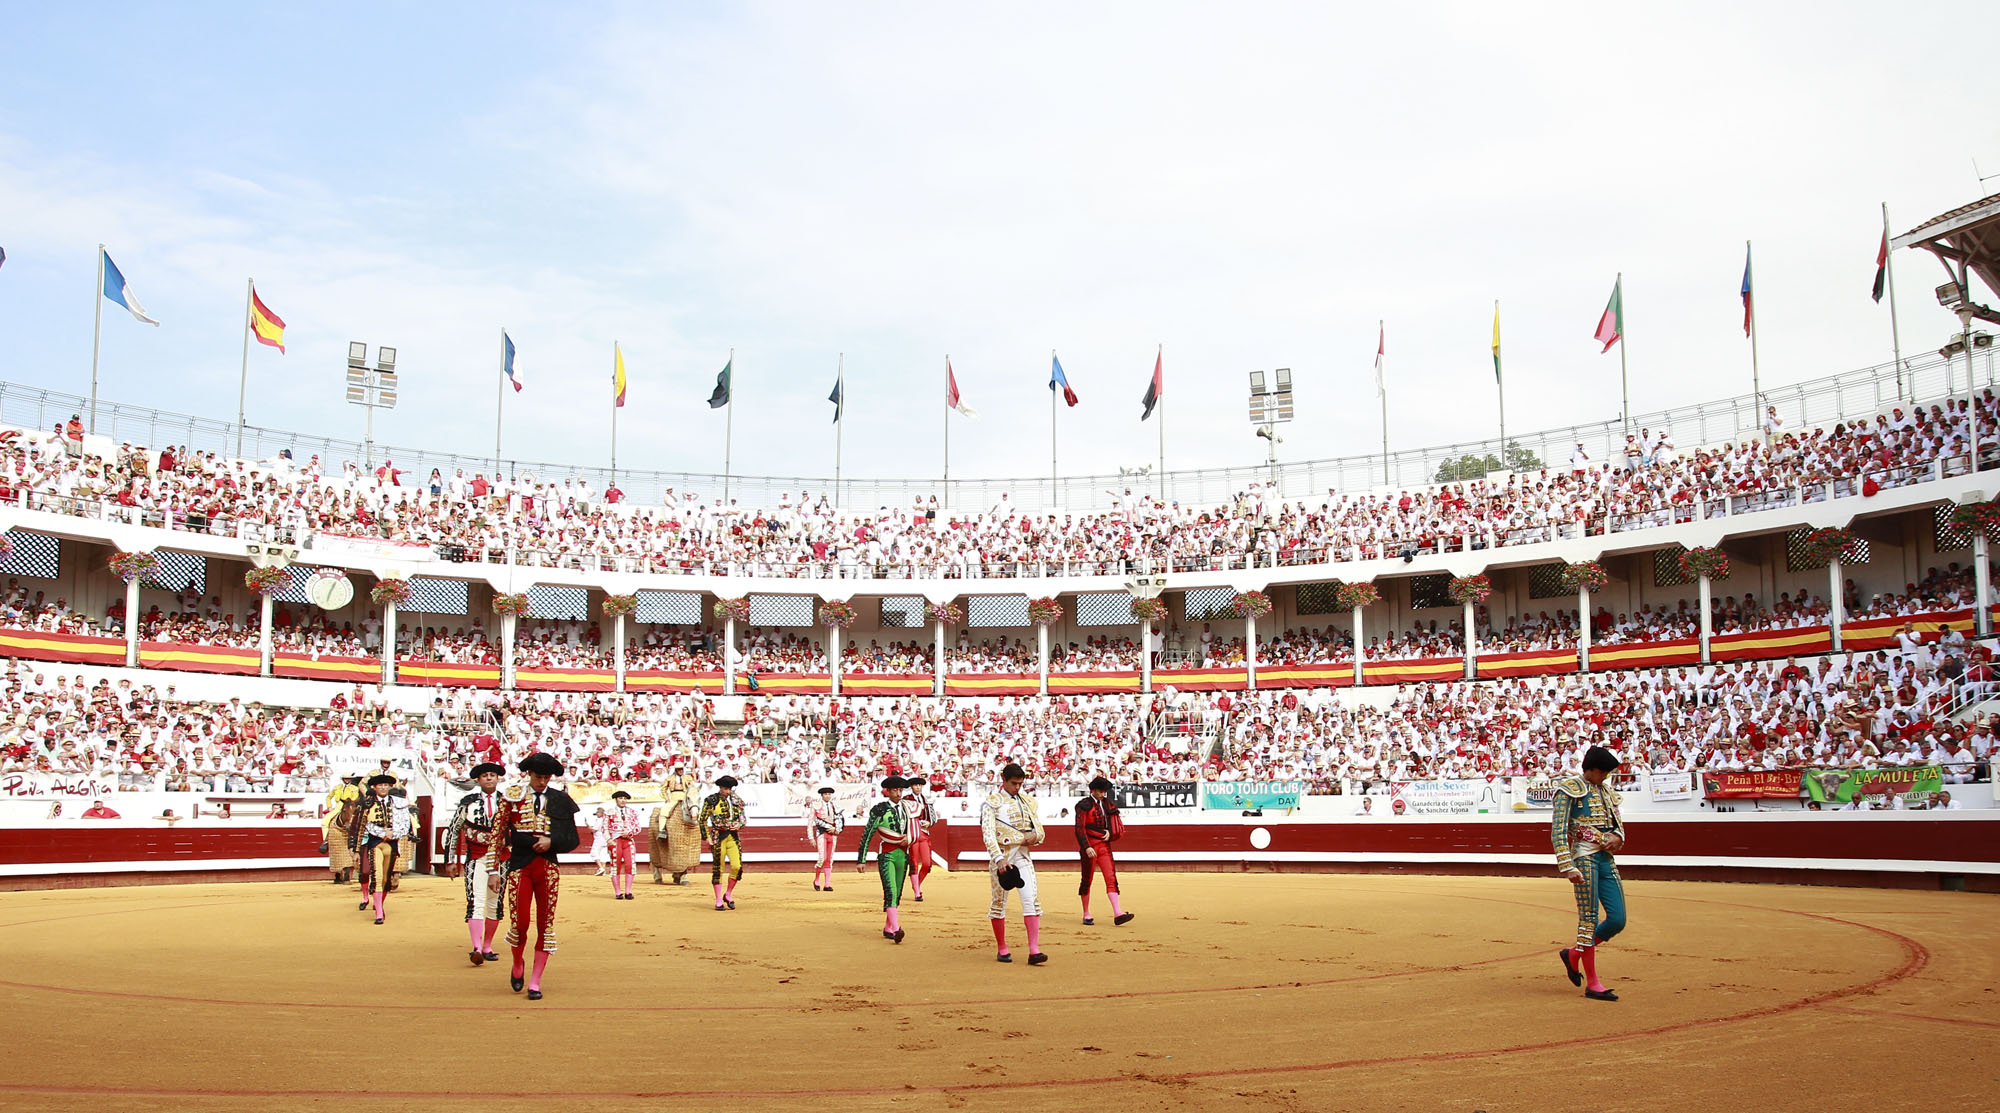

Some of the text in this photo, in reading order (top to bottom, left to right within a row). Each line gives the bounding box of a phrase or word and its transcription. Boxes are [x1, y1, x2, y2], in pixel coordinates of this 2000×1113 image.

[1727, 774, 1751, 785] Peña
[1754, 773, 1765, 785] El
[1855, 767, 1939, 785] LA MULETA
[1205, 782, 1299, 795] TORO TOUTI CLUB
[1414, 781, 1471, 792] Saint-Sever
[1125, 792, 1146, 807] LA
[1278, 797, 1297, 805] DAX
